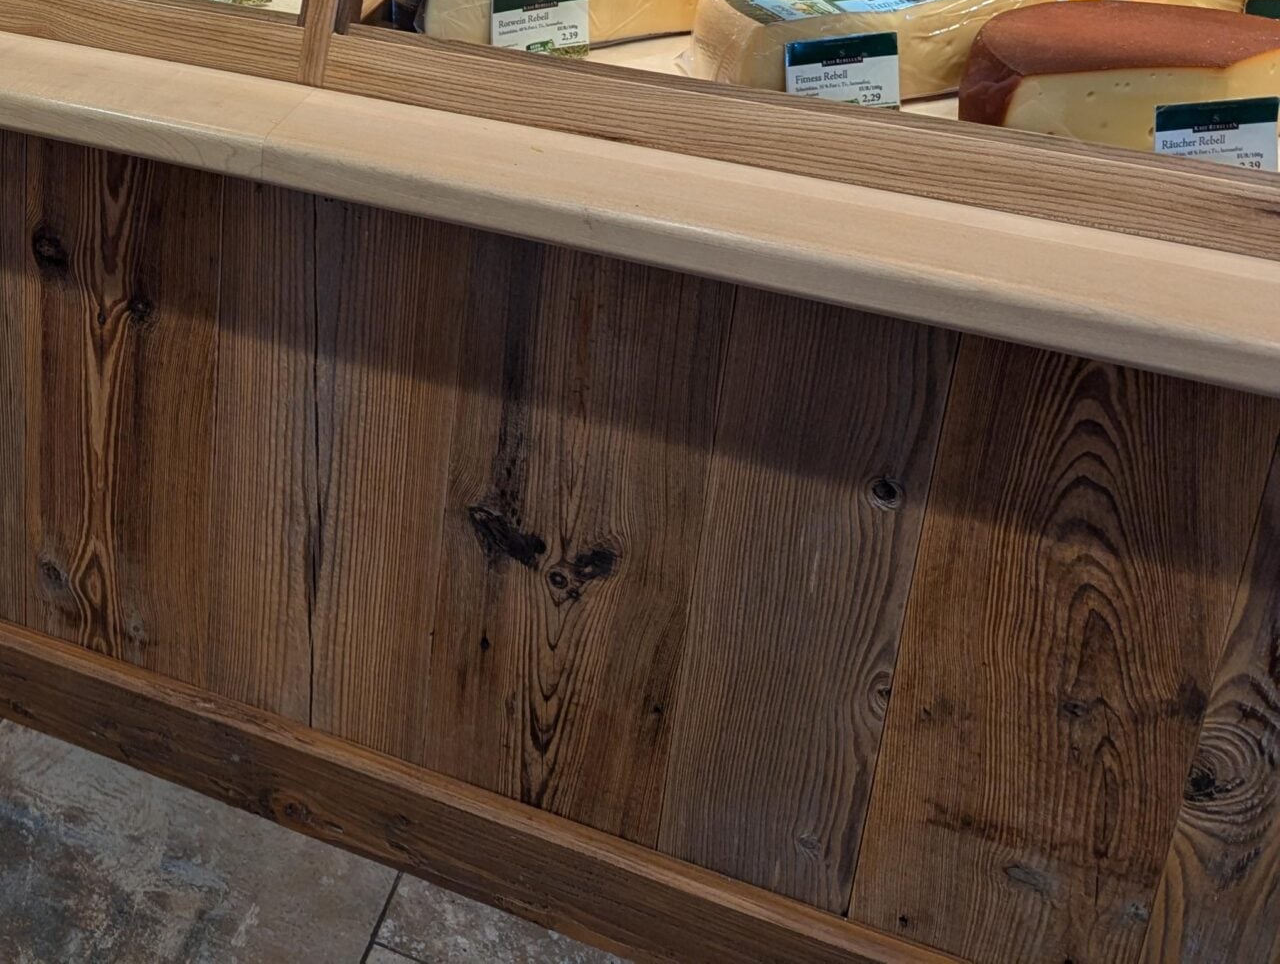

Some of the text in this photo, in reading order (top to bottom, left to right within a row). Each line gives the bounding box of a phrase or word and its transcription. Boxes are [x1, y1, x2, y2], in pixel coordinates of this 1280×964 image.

[498, 12, 549, 28] Rotwein Rebell
[561, 31, 578, 41] 2,39
[795, 70, 848, 84] Fitness Rebell
[862, 93, 881, 103] 2,29
[1161, 134, 1226, 150] Räucher Rebell
